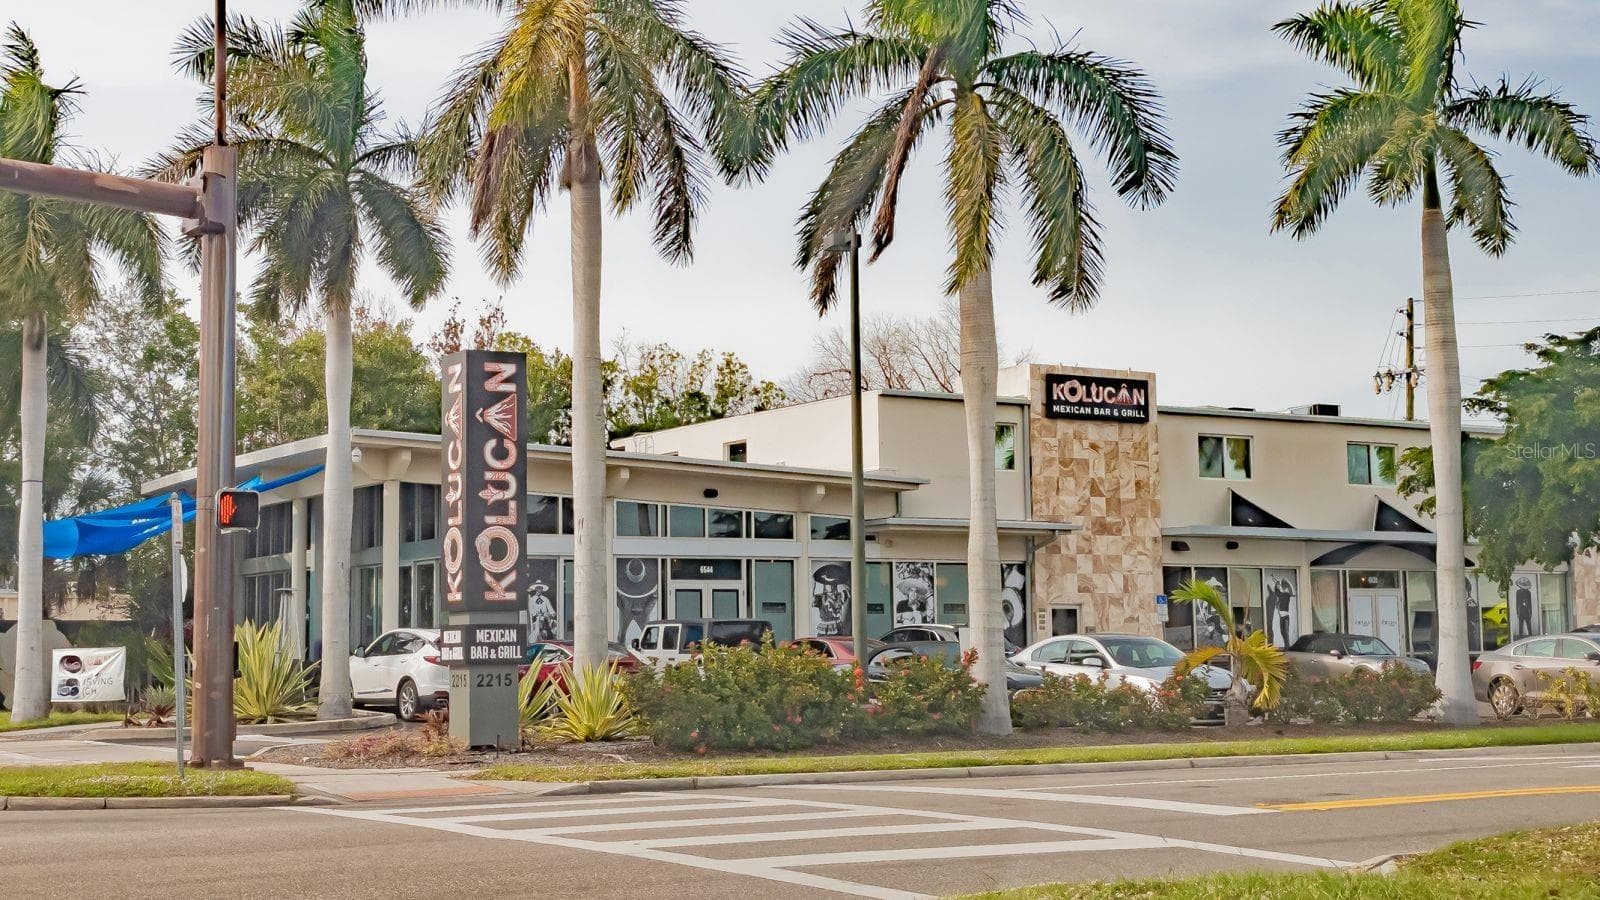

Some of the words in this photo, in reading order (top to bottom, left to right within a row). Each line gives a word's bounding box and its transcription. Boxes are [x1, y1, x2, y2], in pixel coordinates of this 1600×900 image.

[1053, 405, 1091, 414] MEXICAN
[1093, 407, 1111, 416] BAR
[1121, 409, 1145, 418] GRILL
[476, 629, 516, 642] MEXICAN
[470, 646, 488, 659] BAR
[490, 648, 497, 659] &
[498, 645, 522, 659] GRILL
[451, 674, 467, 688] 2215
[476, 673, 513, 688] 2215
